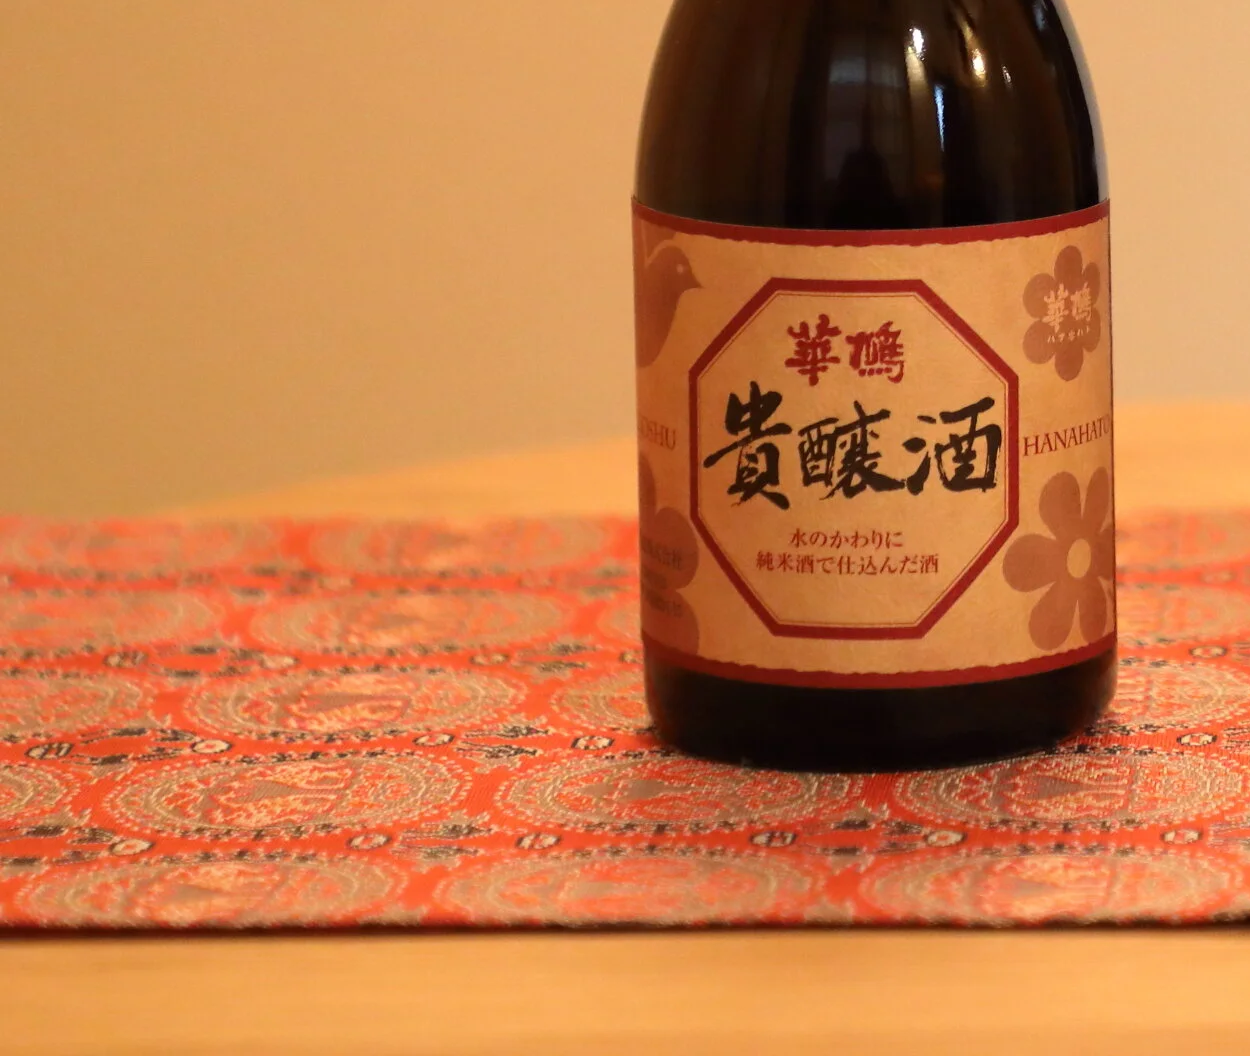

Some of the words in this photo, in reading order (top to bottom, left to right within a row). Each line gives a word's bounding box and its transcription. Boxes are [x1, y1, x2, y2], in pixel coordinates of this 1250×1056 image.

[784, 313, 904, 385] 華鳩
[703, 381, 1002, 510] 貴醸酒
[755, 550, 940, 576] 純米酒で仕込んだ酒
[789, 528, 904, 550] 水のかわりに
